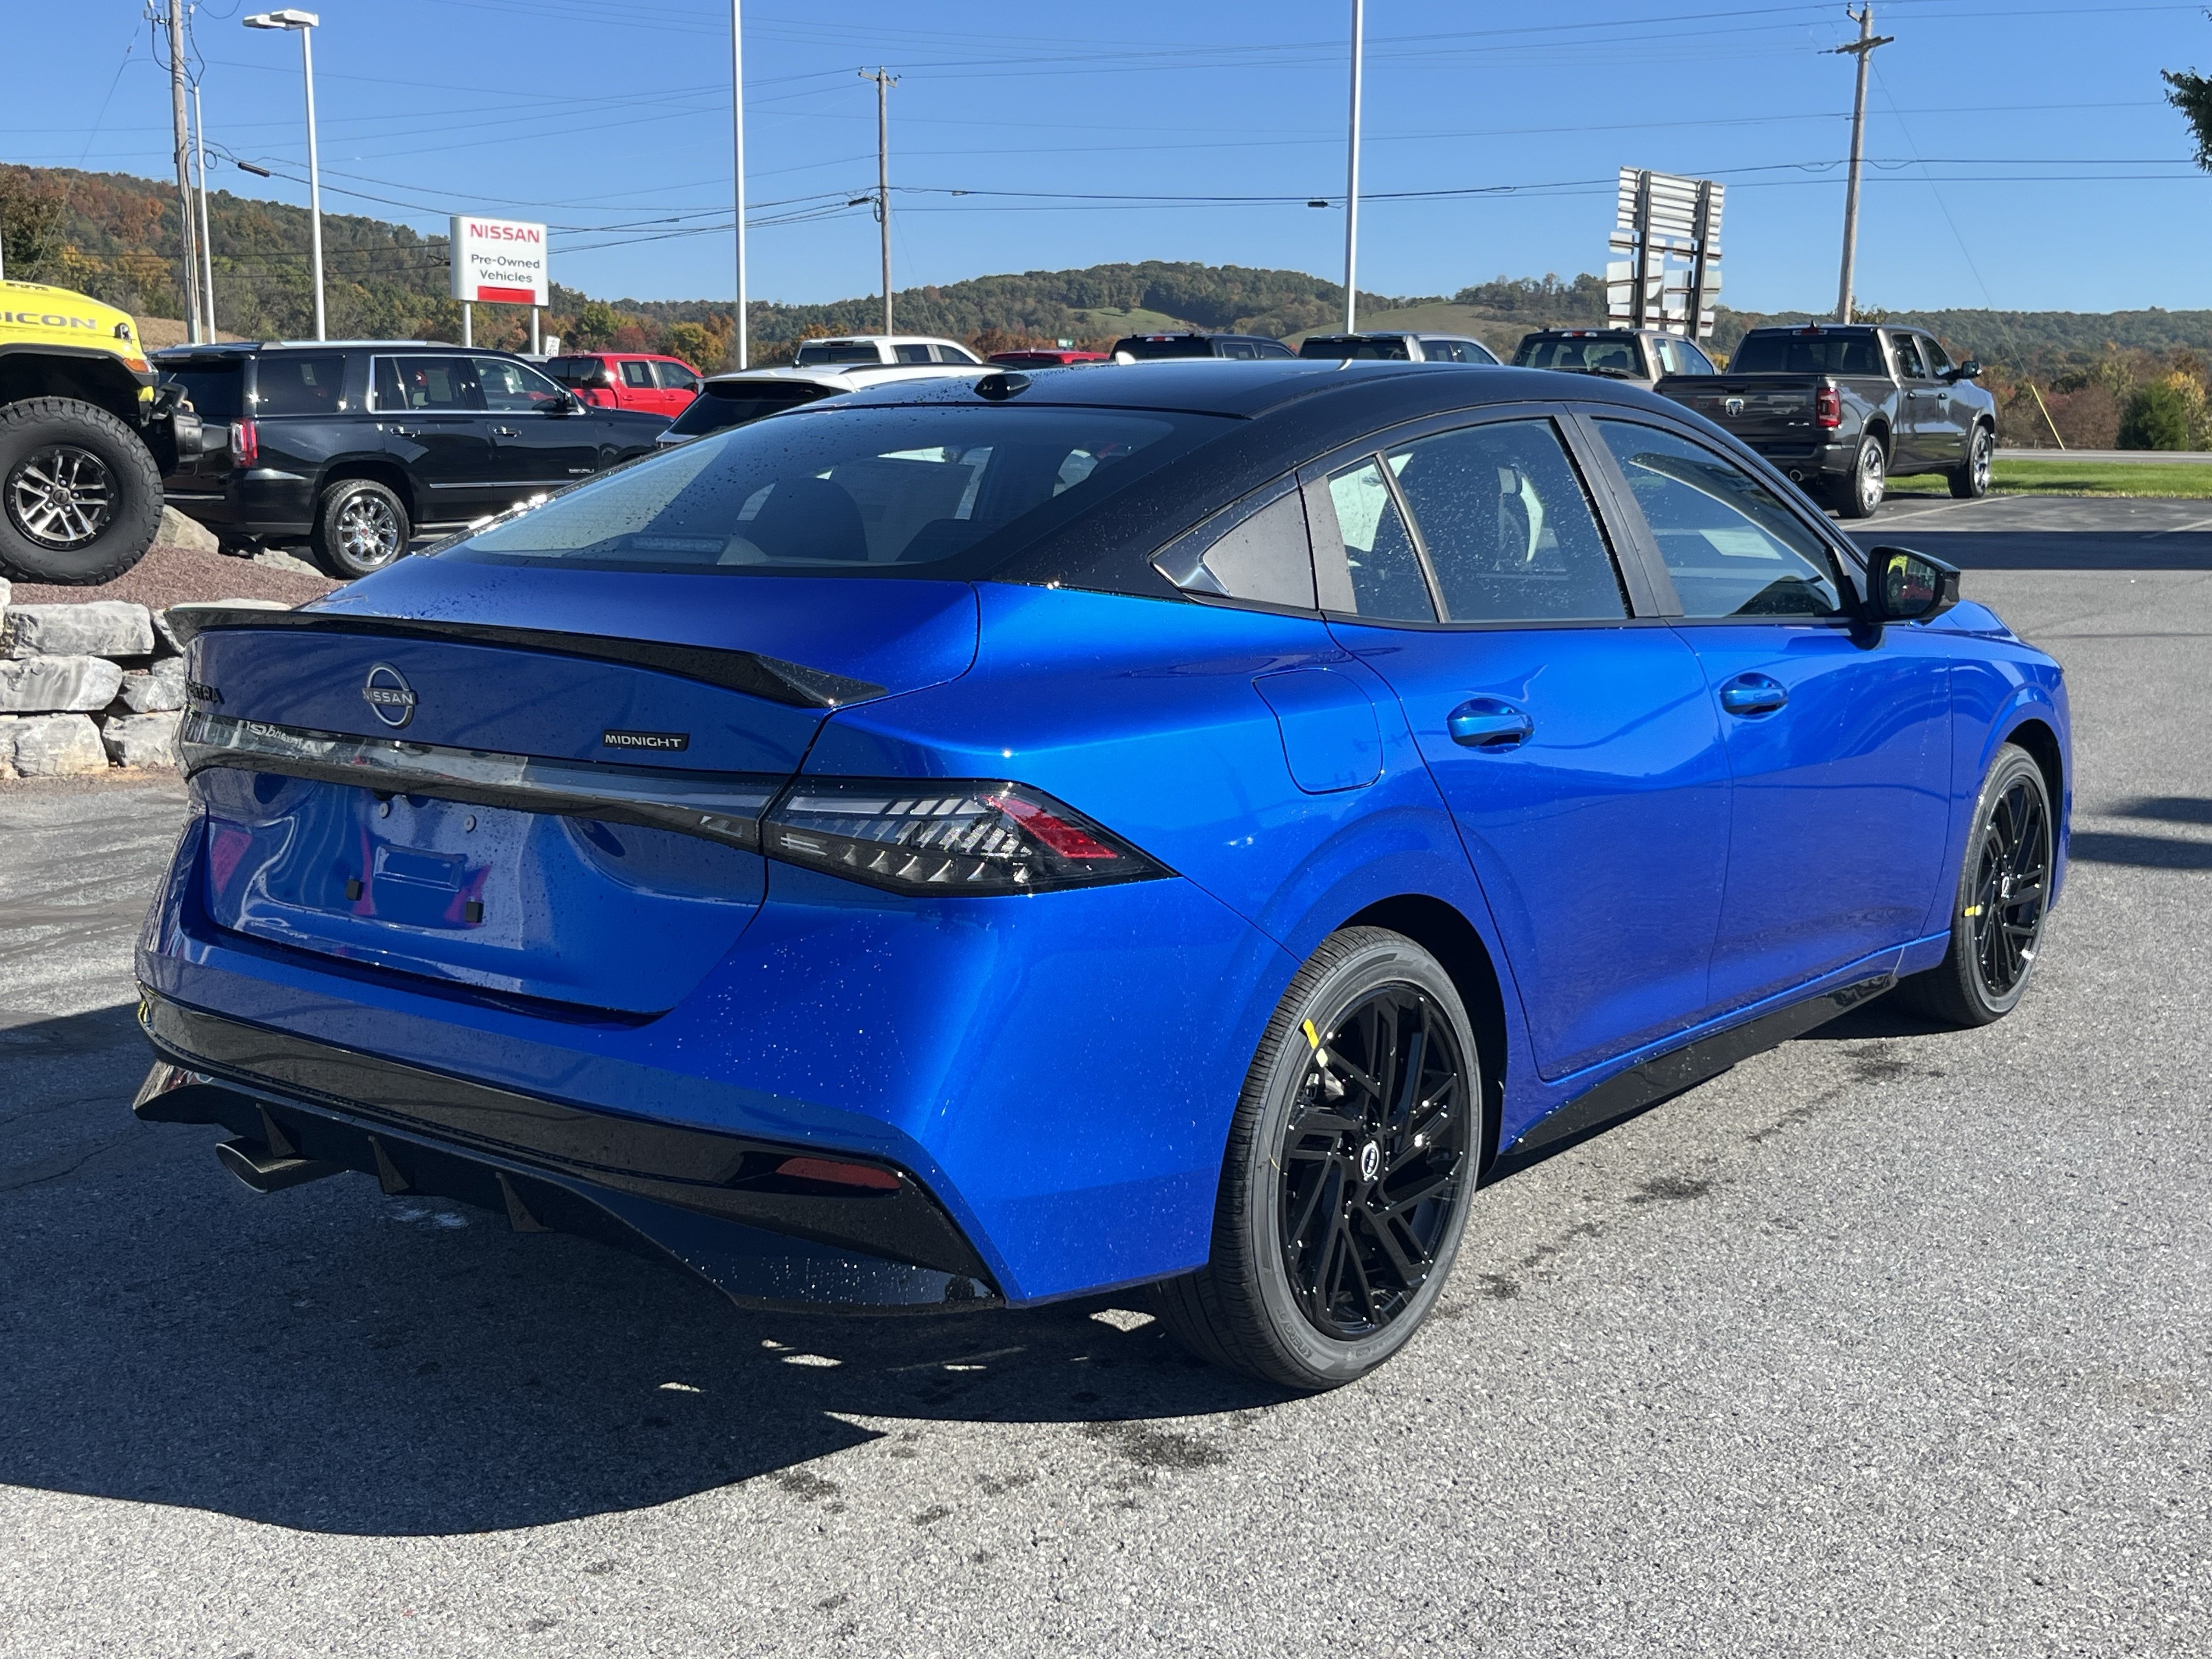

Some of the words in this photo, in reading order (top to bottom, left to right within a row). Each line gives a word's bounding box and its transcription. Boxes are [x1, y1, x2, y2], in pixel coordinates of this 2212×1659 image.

[470, 223, 540, 243] NISSAN
[471, 254, 540, 268] Pre-Owned
[479, 269, 533, 283] Vehicles
[0, 312, 97, 329] ICON
[363, 690, 414, 704] NISSAN
[605, 735, 682, 747] MIDNIGHT
